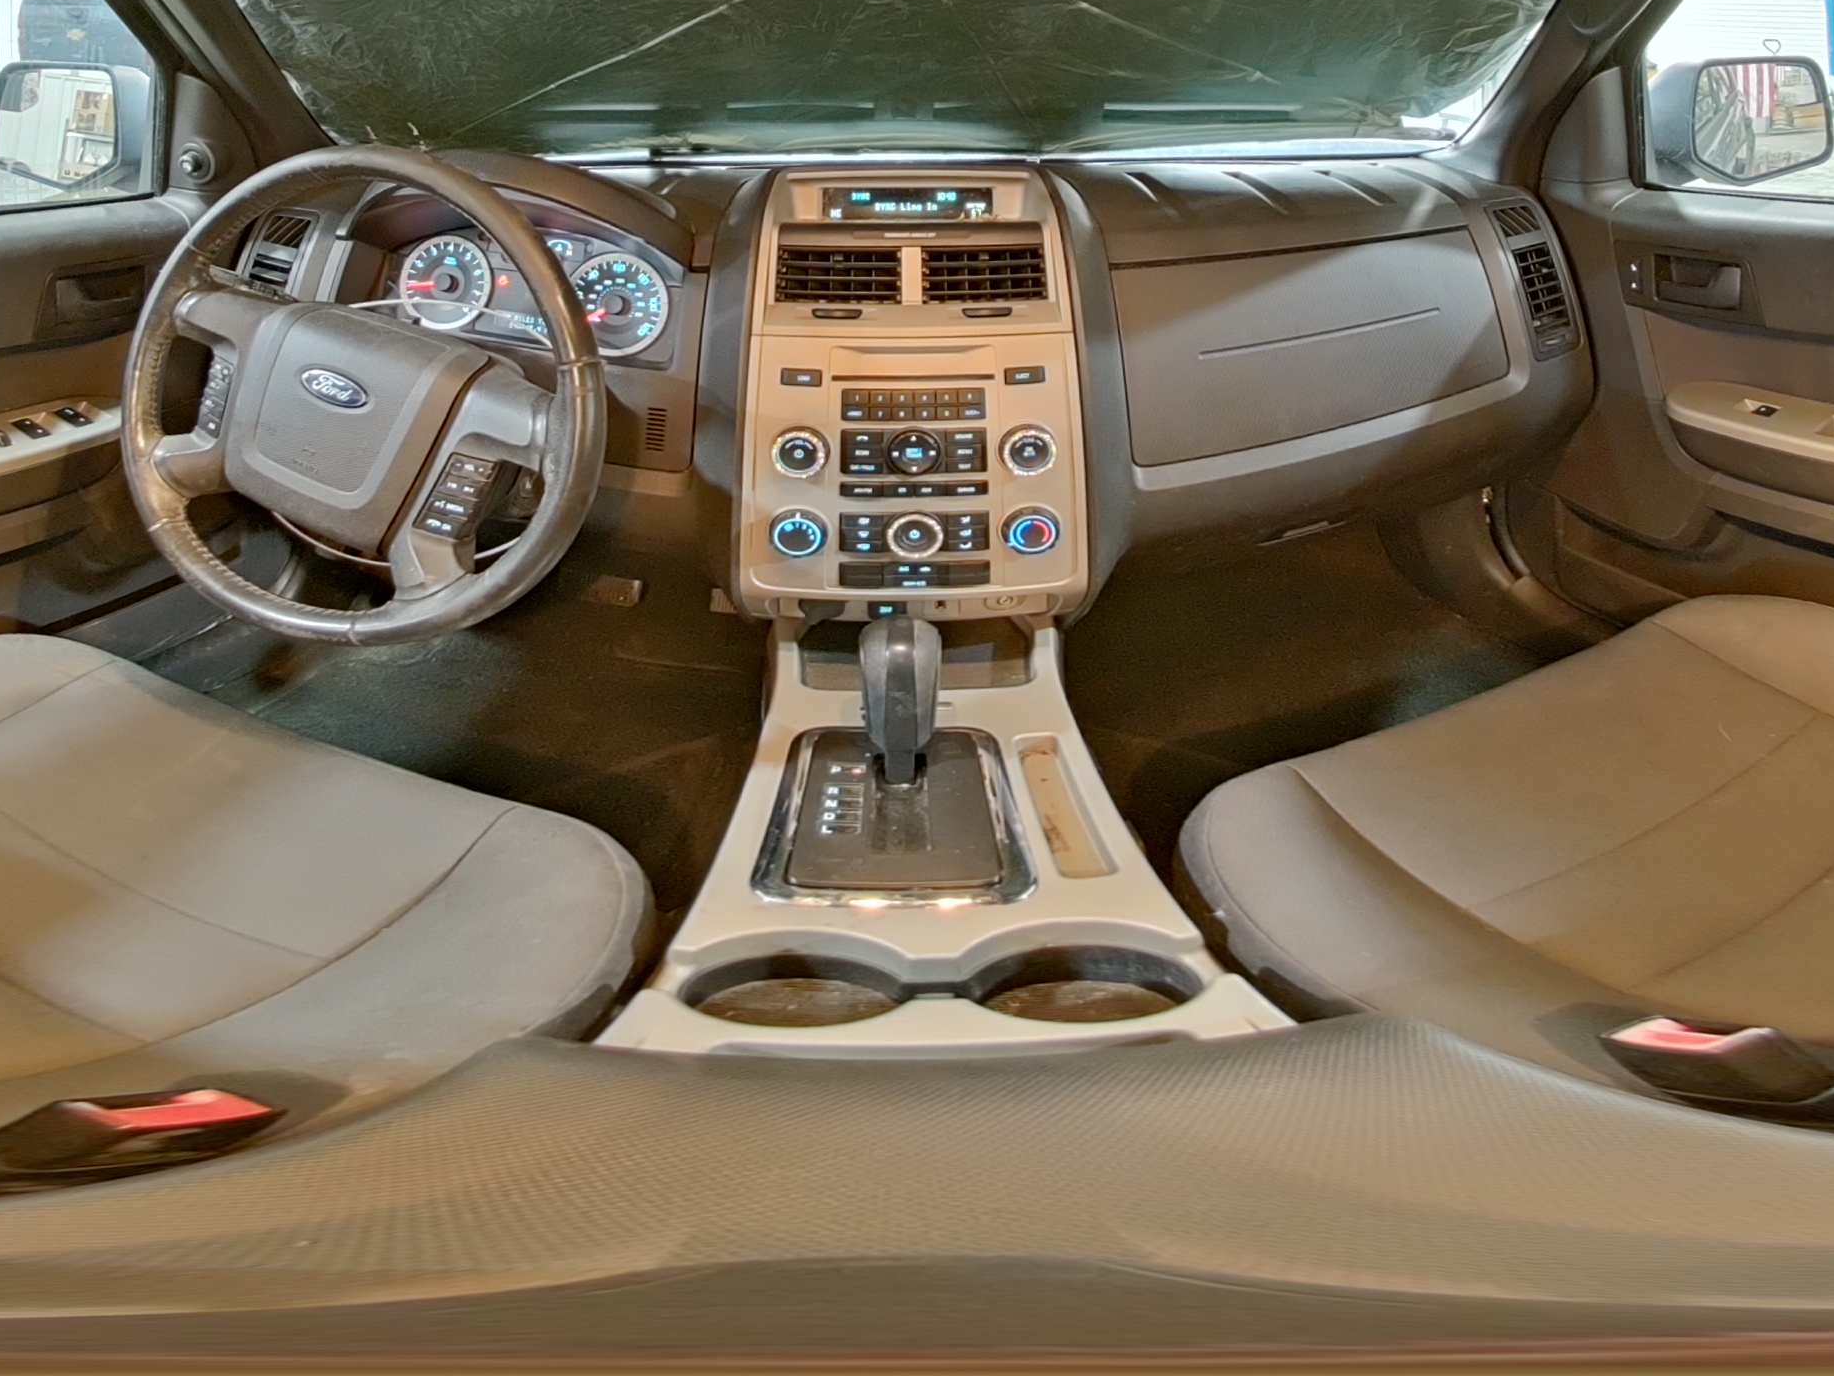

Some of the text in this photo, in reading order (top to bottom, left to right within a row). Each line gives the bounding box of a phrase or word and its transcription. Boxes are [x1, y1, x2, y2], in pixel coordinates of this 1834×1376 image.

[874, 202, 938, 212] SYNC Line In
[829, 208, 843, 219] NE
[613, 263, 627, 273] 60
[311, 374, 354, 402] Ford
[464, 463, 475, 472] VOL
[830, 765, 842, 774] P
[827, 786, 840, 795] R
[823, 812, 836, 821] D
[820, 824, 834, 834] L
